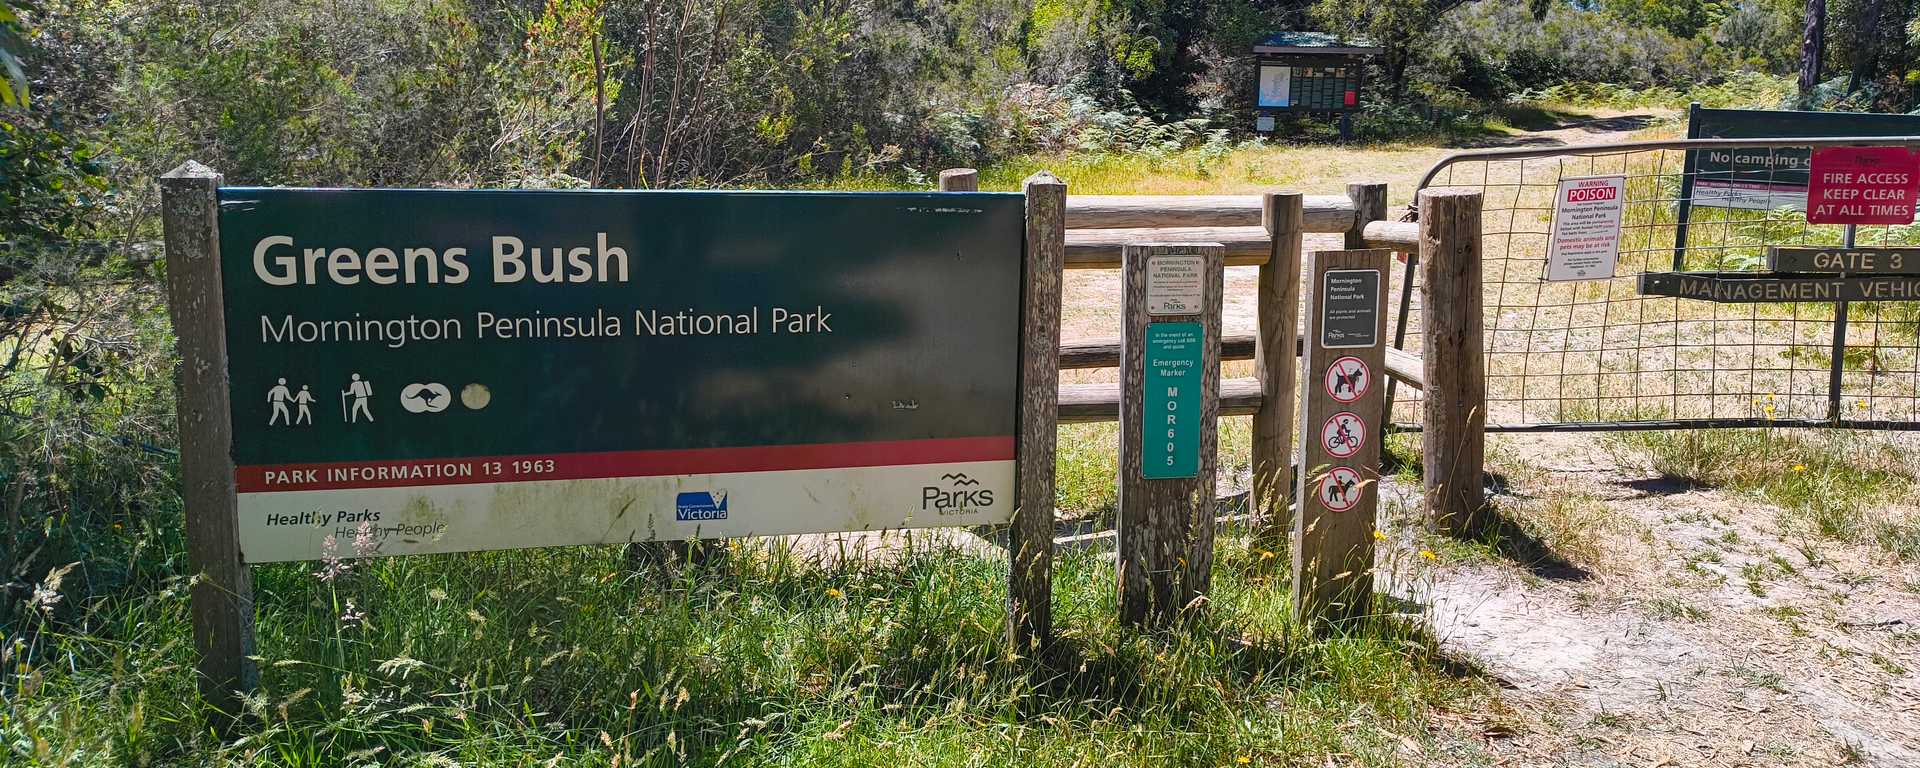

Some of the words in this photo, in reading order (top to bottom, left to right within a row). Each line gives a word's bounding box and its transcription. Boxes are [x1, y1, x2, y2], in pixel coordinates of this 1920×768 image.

[1710, 151, 1729, 163] No
[1735, 153, 1798, 169] camping
[1578, 180, 1609, 188] WARNING
[1823, 173, 1853, 184] FIRE
[1857, 173, 1909, 184] ACCESS
[1569, 188, 1614, 201] POISON
[1823, 188, 1859, 200] KEEP
[1863, 189, 1905, 200] CLEAR
[1815, 204, 1835, 216] AT
[1840, 204, 1865, 216] ALL
[1869, 205, 1909, 216] TIMES
[252, 234, 470, 286] Greens
[491, 232, 629, 284] Bush
[1813, 252, 1876, 269] GATE
[1889, 253, 1903, 269] 3
[1679, 279, 1845, 300] MANAGEMENT
[260, 312, 461, 348] Mornington
[477, 309, 621, 340] Peninsula
[635, 306, 757, 337] National
[772, 306, 833, 334] Park
[1153, 358, 1194, 369] Emergency
[1160, 369, 1186, 377] Marker
[264, 469, 319, 485] PARK
[327, 462, 473, 483] INFORMATION
[482, 461, 502, 476] 13
[512, 459, 556, 474] 1963
[922, 486, 994, 510] Parks
[336, 509, 381, 523] Parks
[678, 508, 727, 520] Victoria
[396, 520, 446, 537] People
